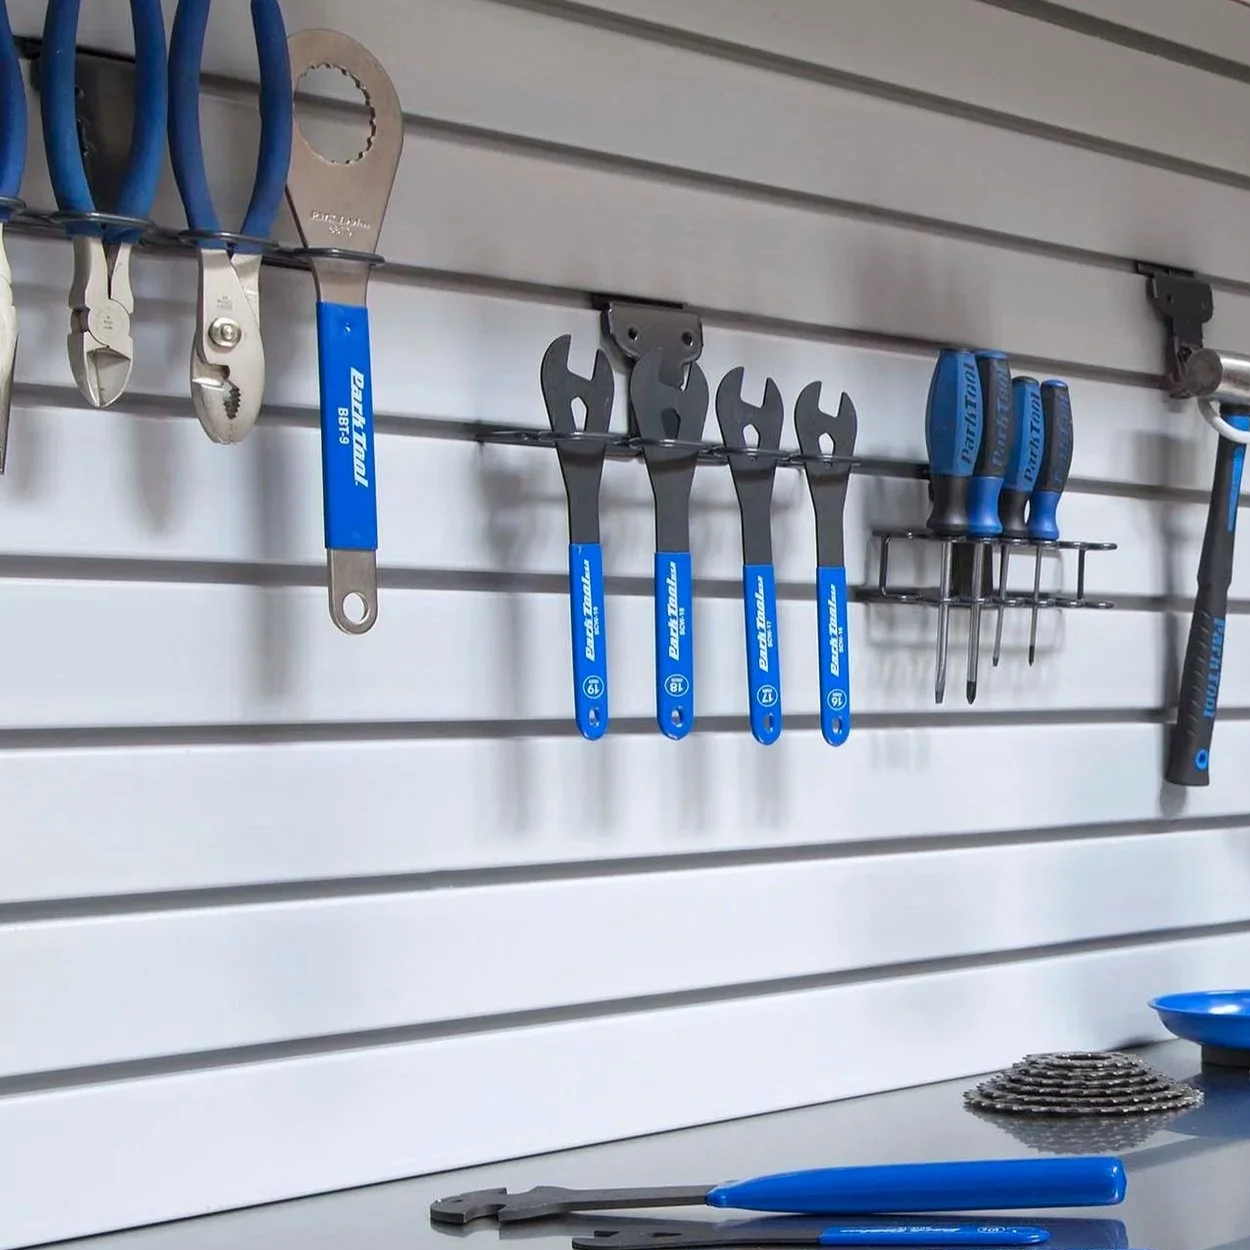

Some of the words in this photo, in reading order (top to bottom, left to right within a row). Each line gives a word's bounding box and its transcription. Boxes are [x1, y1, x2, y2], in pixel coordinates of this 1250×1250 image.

[350, 366, 367, 430] Park
[964, 361, 976, 410] Tool
[337, 406, 350, 445] BBT-9
[1029, 391, 1041, 433] Tool
[961, 410, 978, 465] Park
[1023, 433, 1041, 482] Park
[353, 430, 369, 488] Tool
[581, 576, 593, 617] Tool
[666, 577, 678, 617] Tool
[754, 592, 766, 630] Tool
[827, 599, 838, 636] Tool
[583, 617, 596, 662] Park
[667, 617, 679, 662] Park
[757, 630, 769, 673] Park
[829, 636, 840, 677] Park
[587, 684, 600, 695] 19
[670, 683, 683, 693] 18
[762, 693, 773, 703] 17
[831, 697, 843, 707] 16
